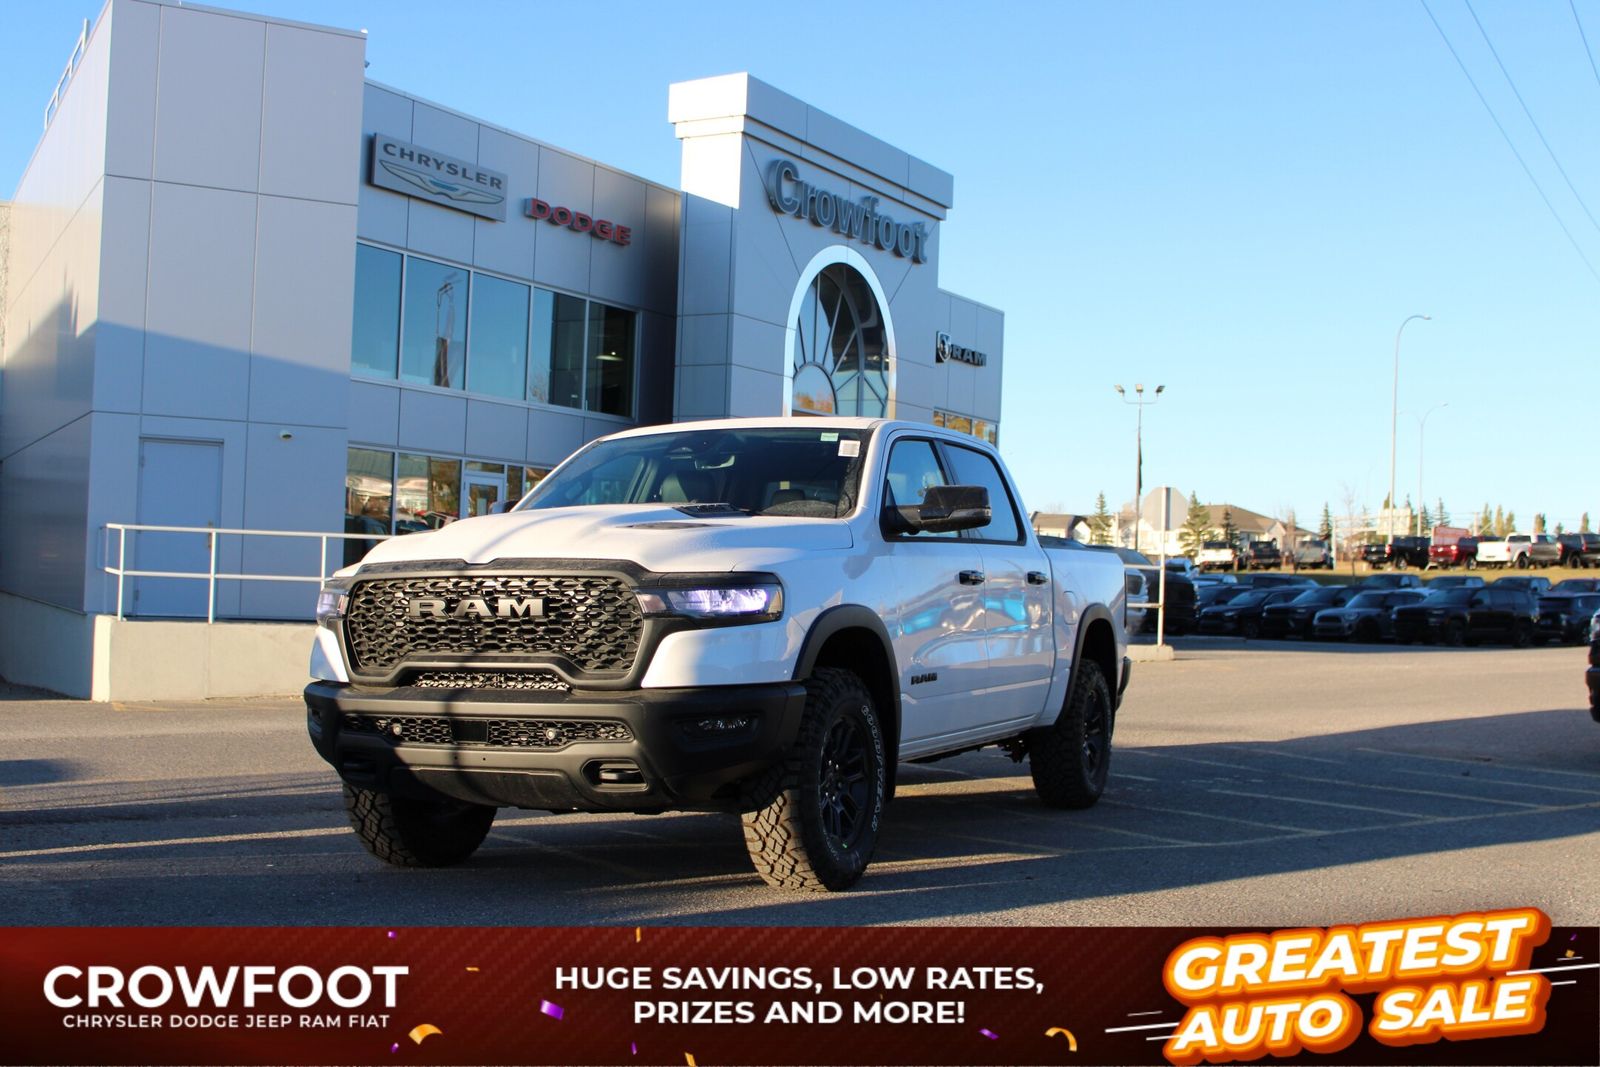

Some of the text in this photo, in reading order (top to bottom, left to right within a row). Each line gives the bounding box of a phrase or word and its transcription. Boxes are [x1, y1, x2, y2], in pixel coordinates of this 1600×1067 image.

[383, 143, 503, 190] CHRYSLER
[527, 197, 631, 245] DODGE
[772, 160, 928, 263] Crowfoot
[951, 344, 987, 367] RAM
[409, 598, 544, 618] RAM
[911, 672, 938, 685] RAM
